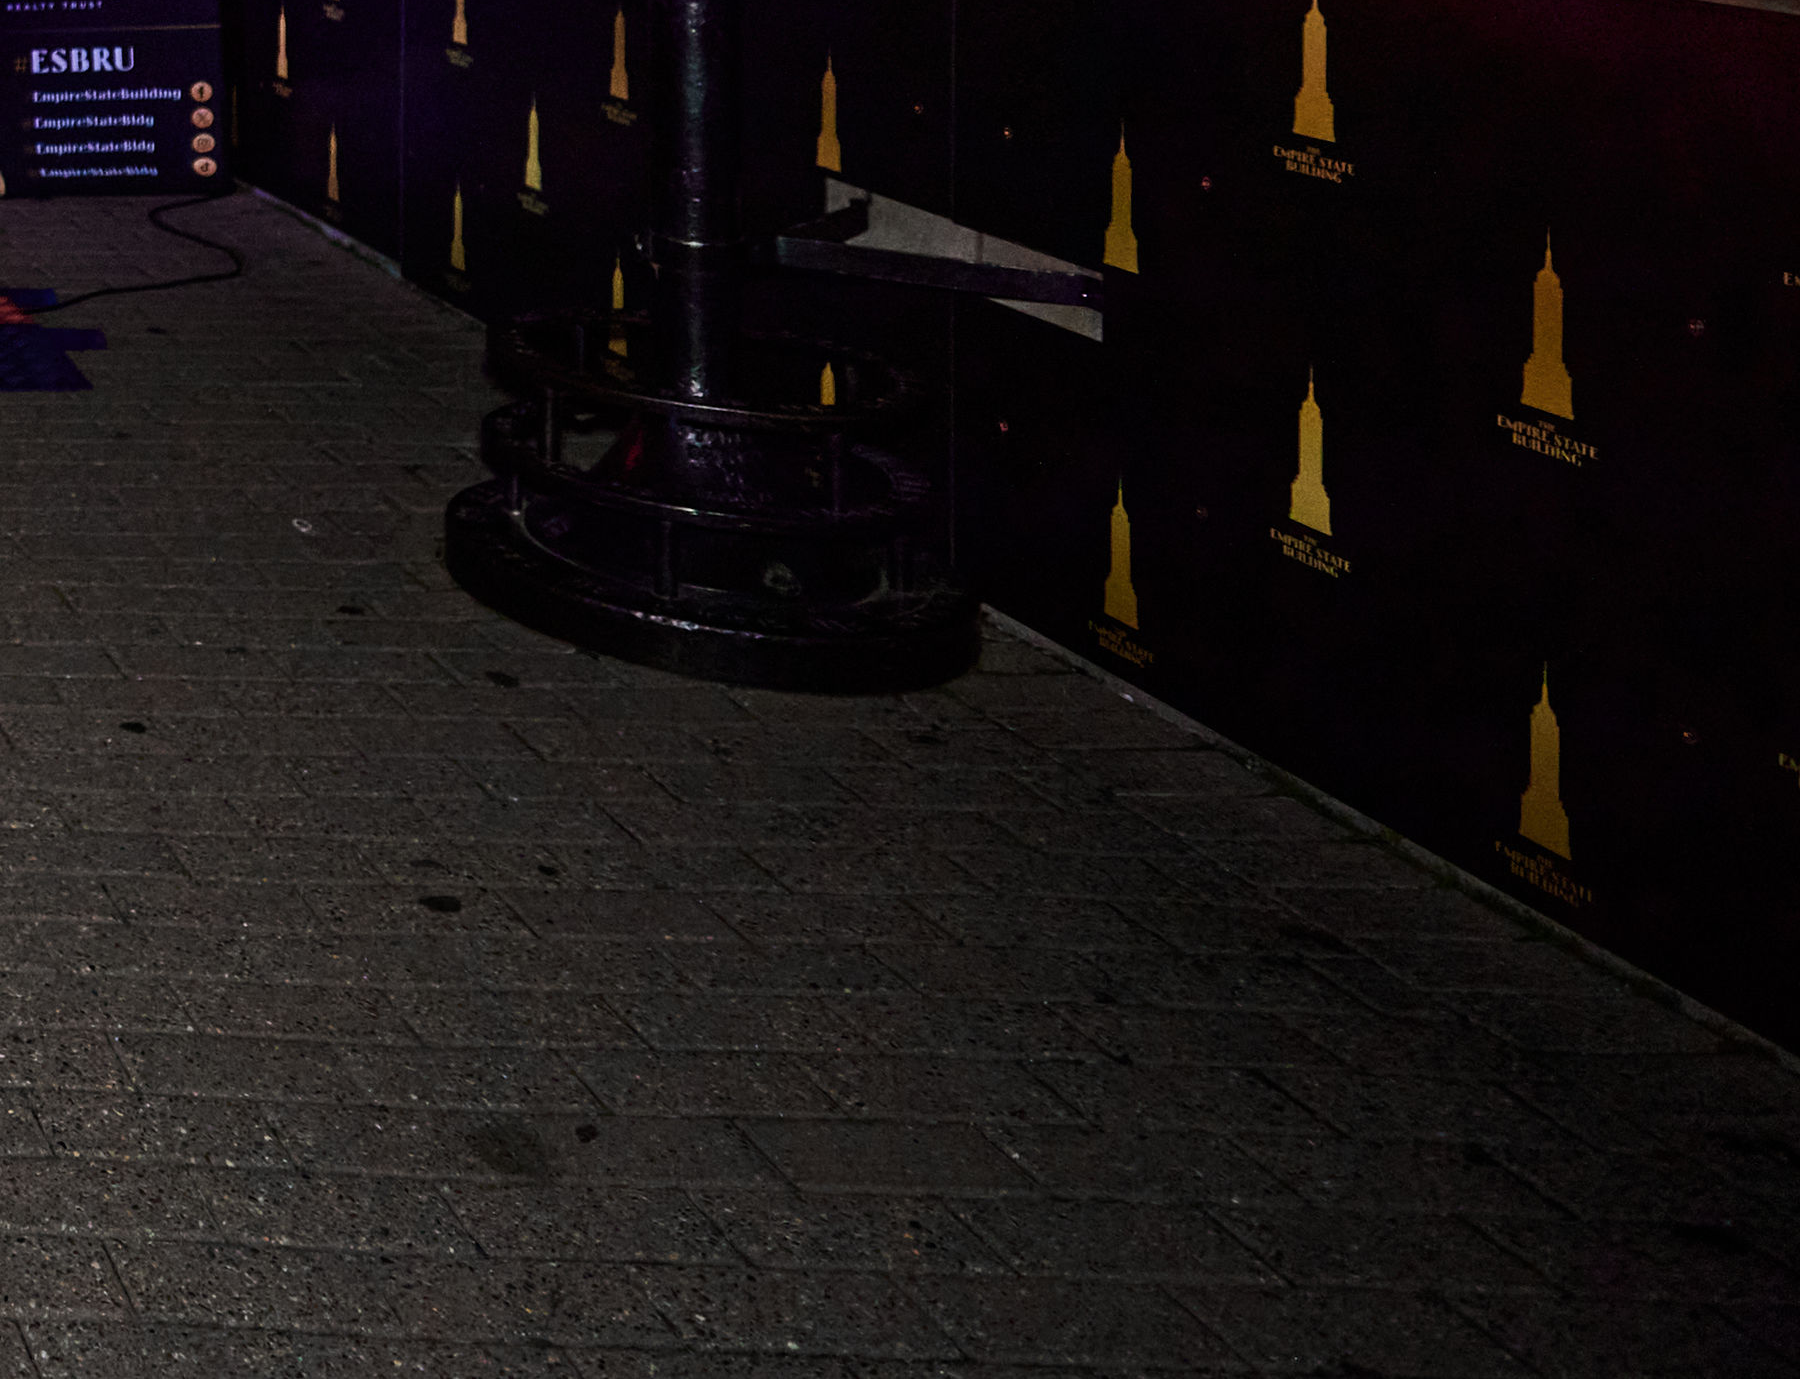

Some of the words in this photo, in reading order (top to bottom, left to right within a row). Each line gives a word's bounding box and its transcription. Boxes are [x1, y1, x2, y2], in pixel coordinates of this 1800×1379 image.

[15, 45, 135, 74] #ESBRU
[1497, 414, 1549, 442] EMPIRE
[1554, 433, 1600, 460] STATE
[1512, 432, 1582, 467] BUILDING
